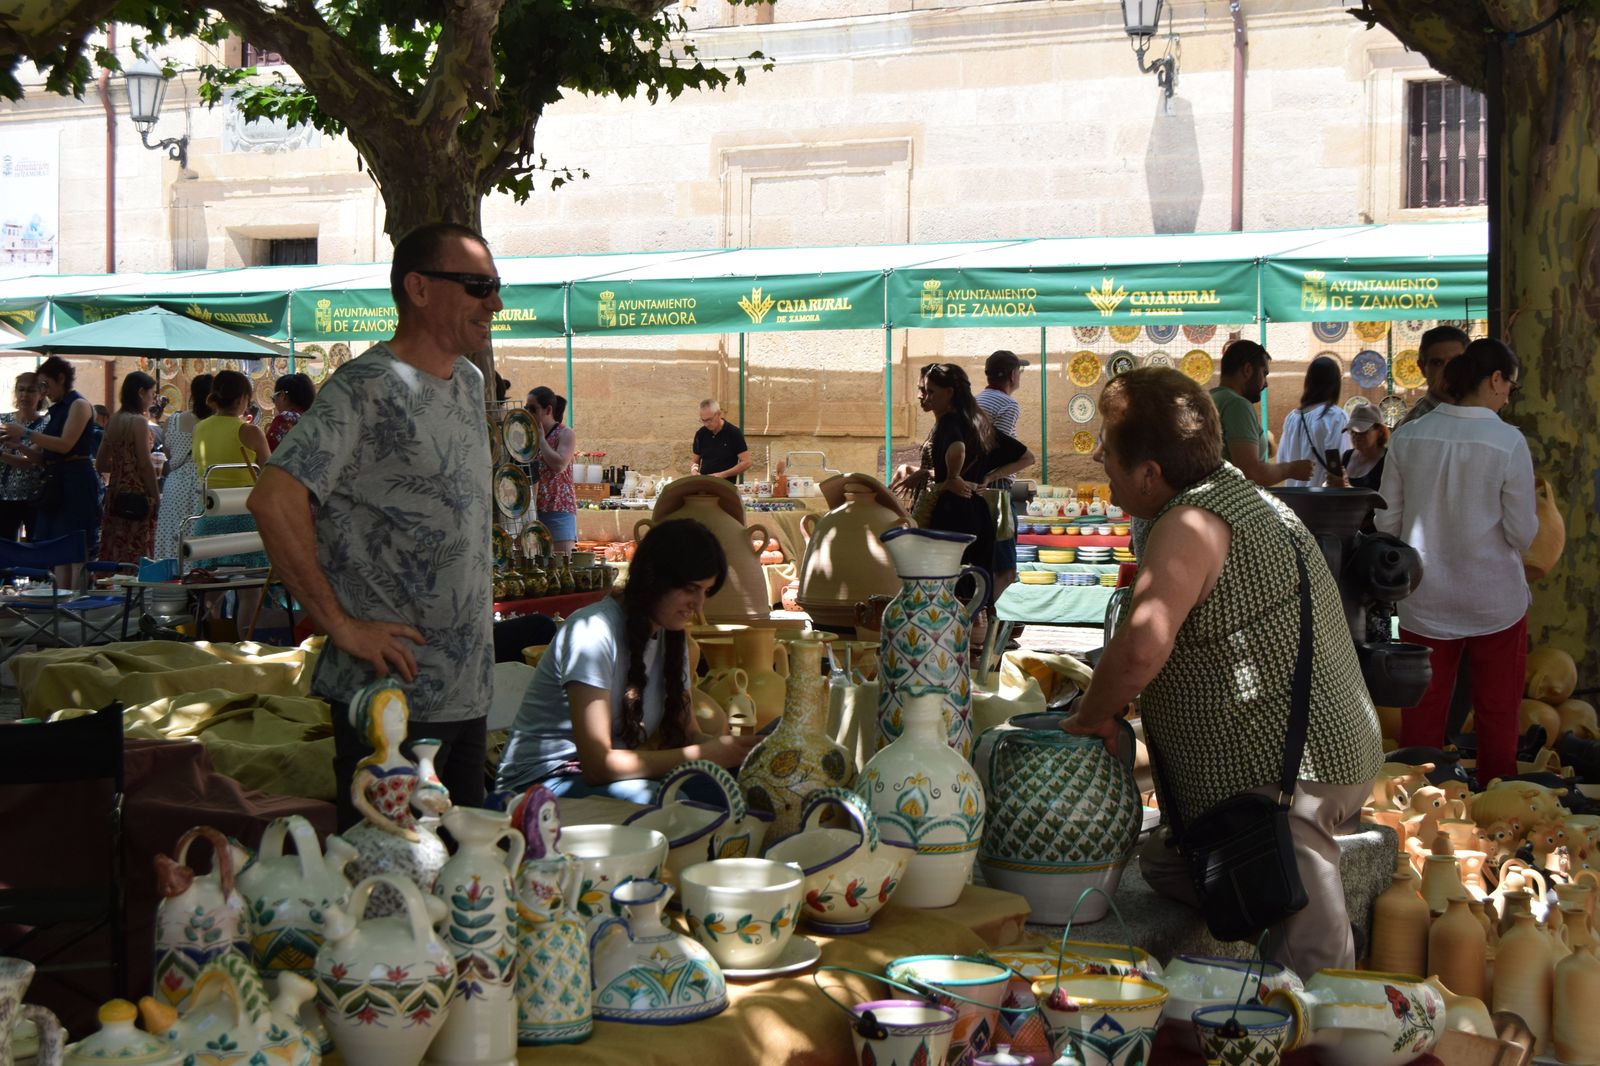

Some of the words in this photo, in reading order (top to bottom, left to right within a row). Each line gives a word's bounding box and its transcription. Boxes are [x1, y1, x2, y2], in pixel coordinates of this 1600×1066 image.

[1330, 277, 1439, 292] AYUNTAMIENTO
[946, 287, 1037, 301] AYUNTAMIENTO
[618, 298, 697, 310] AYUNTAMIENTO
[1330, 295, 1353, 311] DE
[1360, 293, 1439, 310] ZAMORA
[947, 303, 966, 318] DE
[971, 302, 1037, 317] ZAMORA
[619, 313, 636, 326] DE
[640, 311, 697, 326] ZAMORA
[333, 320, 348, 333] DE
